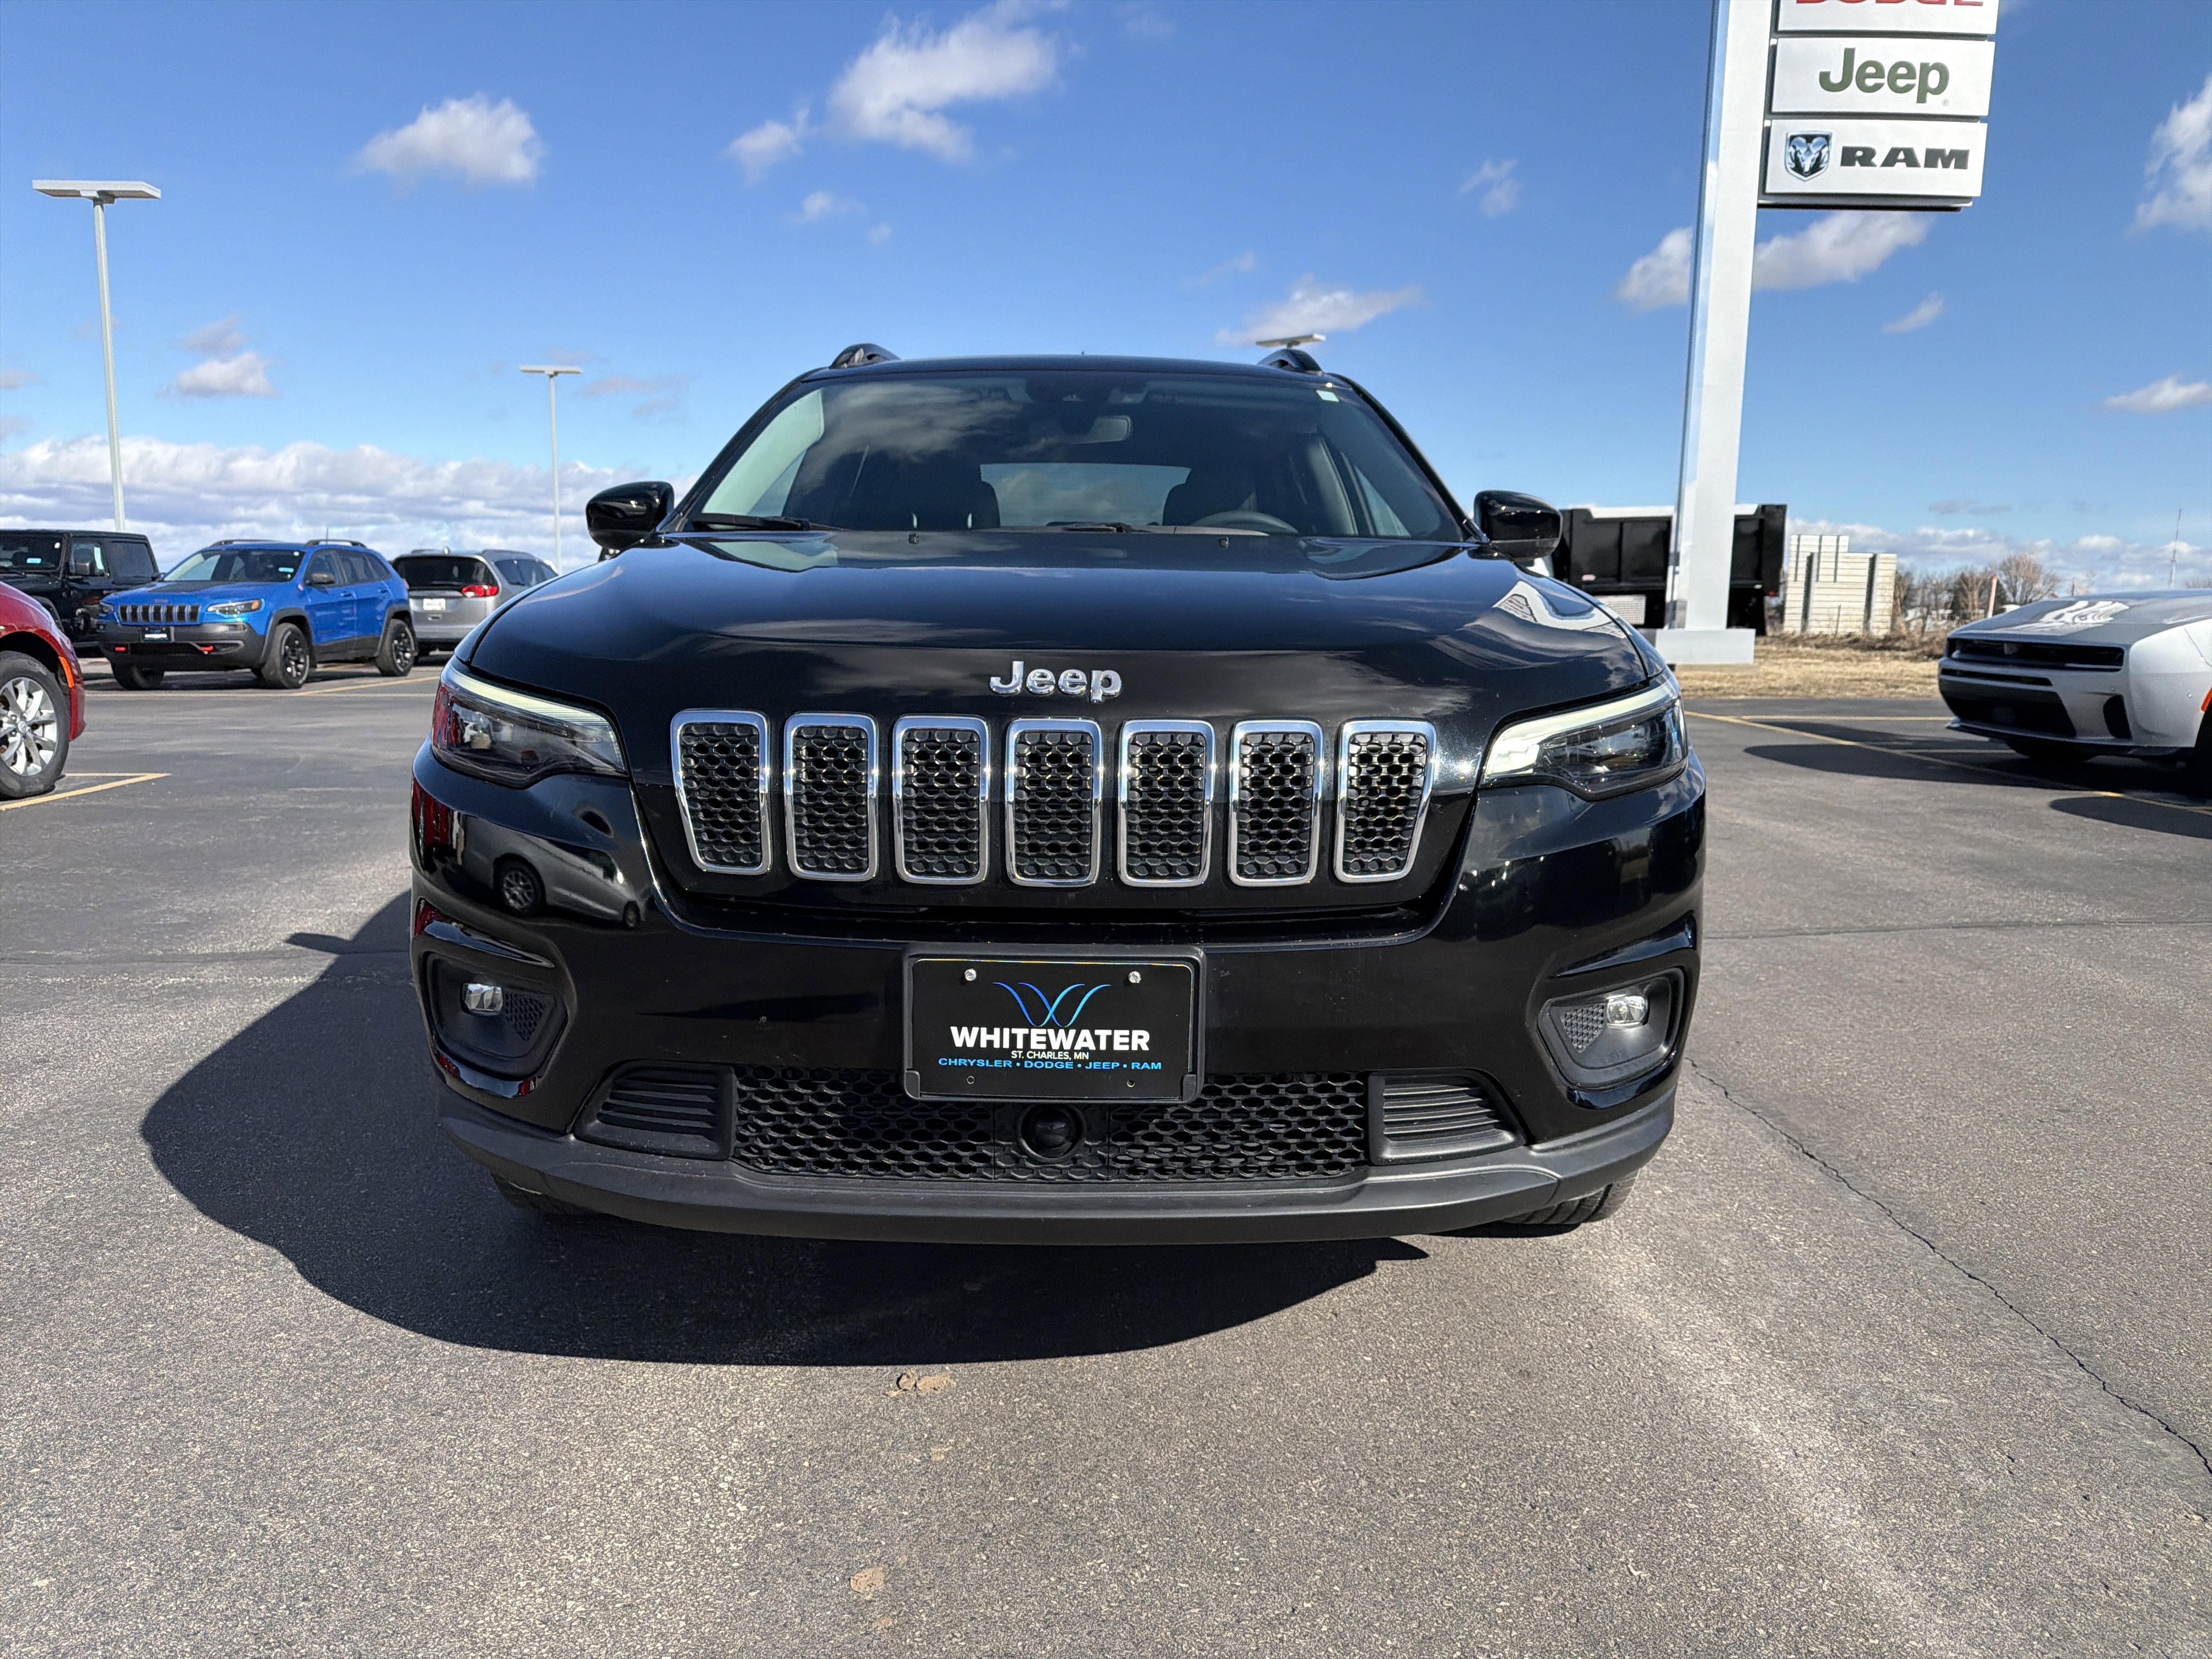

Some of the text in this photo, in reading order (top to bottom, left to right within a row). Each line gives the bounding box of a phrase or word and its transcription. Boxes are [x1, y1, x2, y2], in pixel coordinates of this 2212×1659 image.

[1819, 47, 1949, 103] Jeep
[1840, 146, 1970, 170] RAM
[990, 661, 1122, 703] Jeep
[950, 1026, 1150, 1051] WHITEWATER
[938, 1058, 1012, 1068] CHRYSLER
[1024, 1061, 1074, 1069] DODGE
[1011, 1051, 1089, 1060] ST. CHARLES, MN
